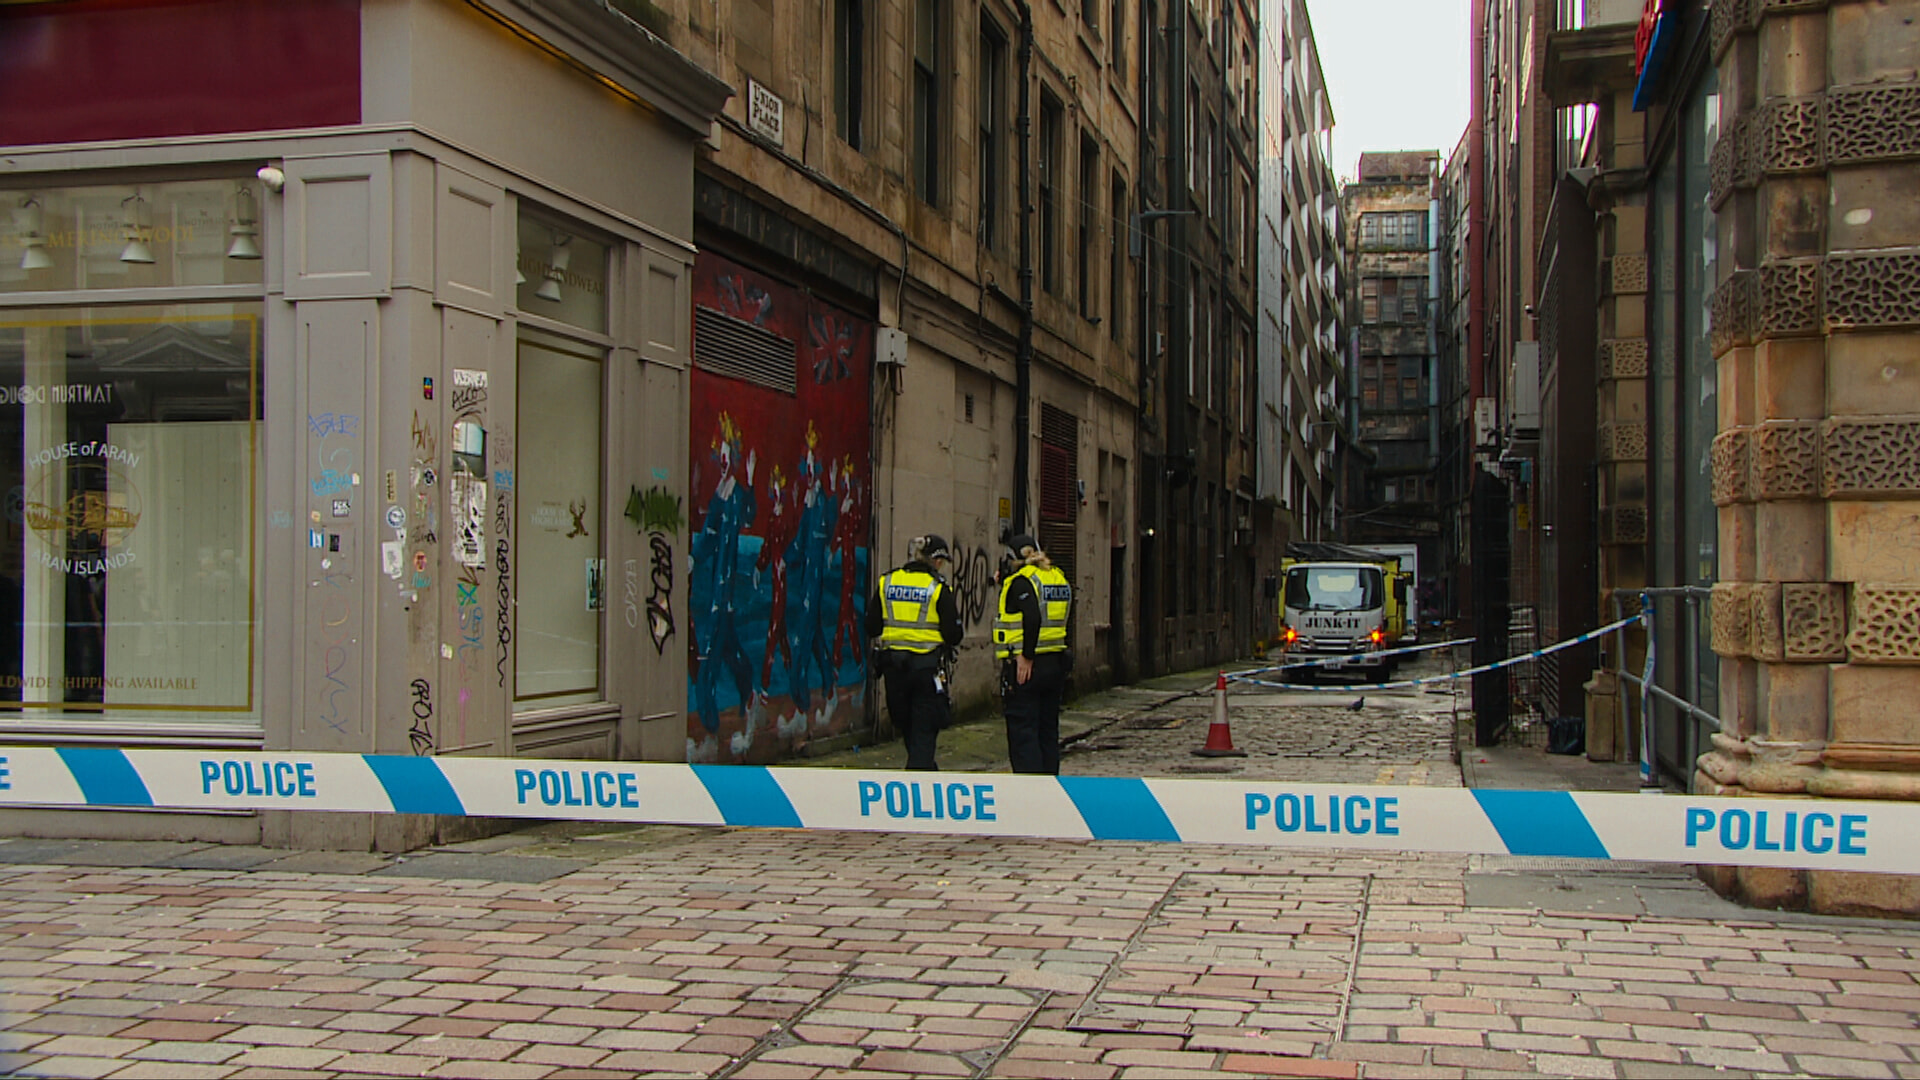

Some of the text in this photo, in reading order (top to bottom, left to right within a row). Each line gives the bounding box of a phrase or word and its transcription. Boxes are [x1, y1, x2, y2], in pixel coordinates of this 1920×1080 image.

[753, 84, 779, 115] UNION
[753, 101, 779, 133] PLACE
[29, 441, 140, 470] HOUSE of ARAN
[31, 547, 137, 575] ARAN ISLANDS
[887, 584, 928, 601] POLICE
[1044, 587, 1070, 600] POLICE
[58, 676, 125, 690] SHIPPING
[128, 676, 198, 690] AVAILABLE
[201, 761, 1867, 854] POLICE POLICE POLICE POLICE POLICE
